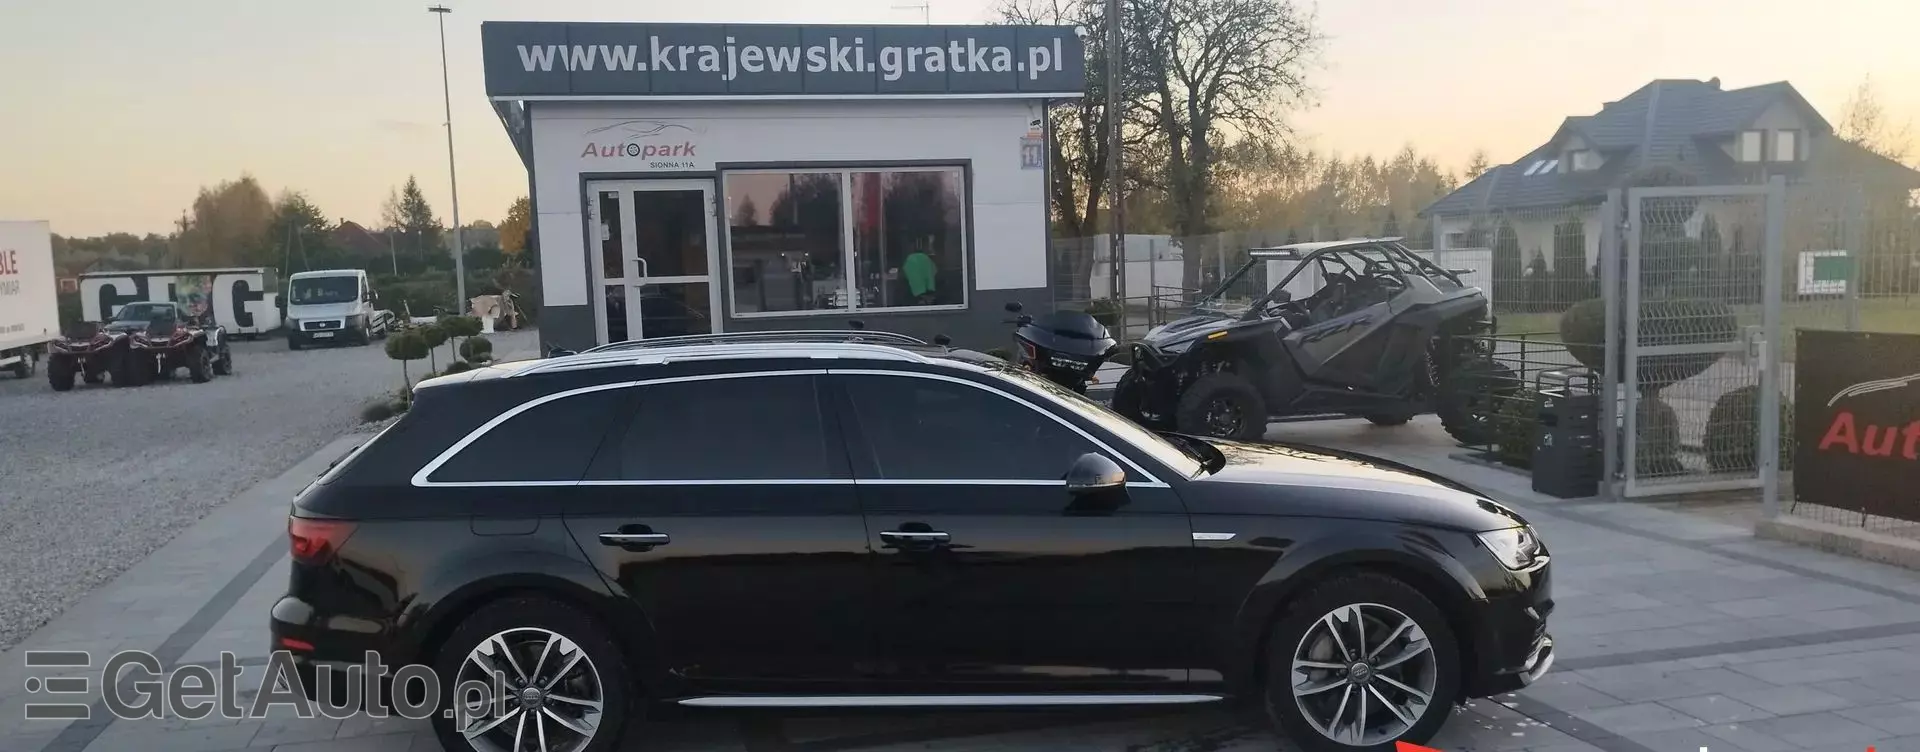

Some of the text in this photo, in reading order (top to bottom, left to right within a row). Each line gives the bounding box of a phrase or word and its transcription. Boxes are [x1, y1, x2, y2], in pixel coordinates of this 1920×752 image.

[517, 35, 1064, 81] www.krajewski.gratka.pl
[650, 161, 695, 169] SIONNA 11A
